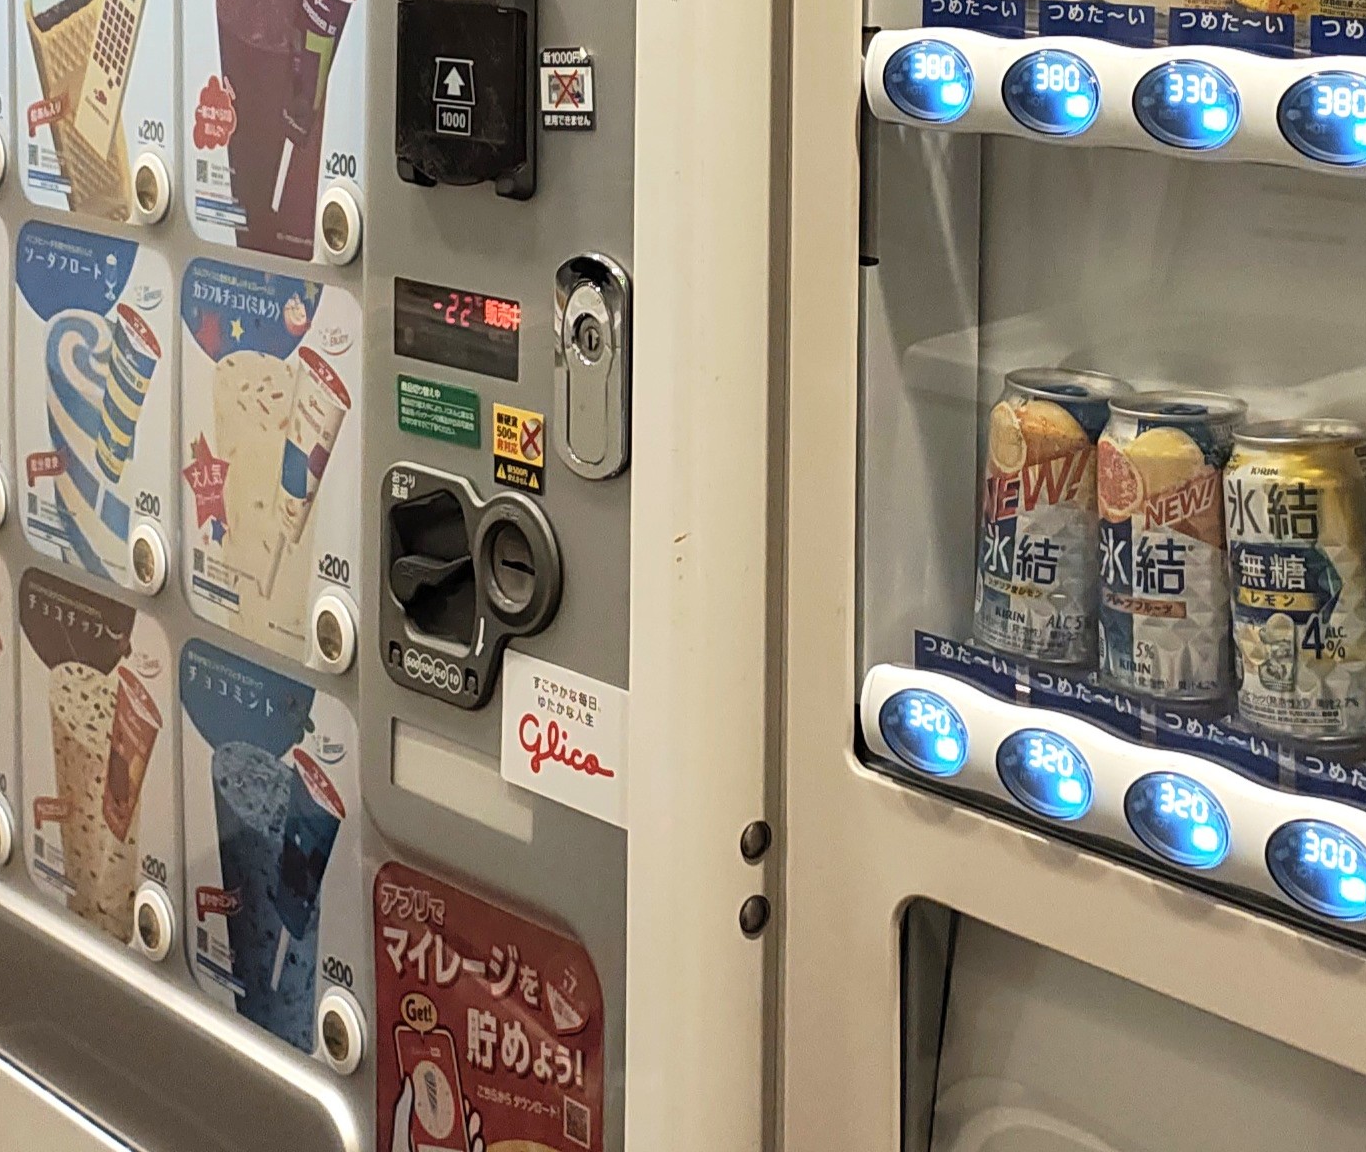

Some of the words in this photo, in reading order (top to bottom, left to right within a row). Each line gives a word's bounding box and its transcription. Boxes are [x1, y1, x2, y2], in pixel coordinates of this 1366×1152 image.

[913, 53, 955, 79] 380
[1035, 62, 1080, 91] 380
[1168, 73, 1218, 103] 330
[138, 119, 165, 144] ¥200
[441, 112, 466, 129] 1000
[544, 115, 591, 126] 使用できません
[325, 151, 357, 179] ¥200
[26, 248, 102, 279] ソーダフロート
[193, 280, 282, 321] カラフルチョコ(ミルク)
[484, 298, 522, 332] 販売中
[496, 412, 518, 428] 新硬貨
[496, 426, 518, 442] 500円
[191, 464, 223, 489] 大人気
[391, 471, 416, 488] おつり
[1251, 466, 1279, 477] KIRIN
[137, 491, 161, 517] ¥200
[1144, 480, 1216, 530] NEW!
[1228, 479, 1325, 540] 氷結
[318, 553, 350, 584] ¥200
[985, 525, 1066, 585] 氷結
[1100, 527, 1194, 595] 氷結
[1238, 549, 1308, 591] 無糖
[1248, 591, 1296, 608] レモン
[995, 607, 1026, 624] KIRIN
[1136, 640, 1155, 657] 5%
[436, 666, 447, 680] 50
[449, 673, 460, 686] 10
[1119, 659, 1151, 674] KIRIN
[189, 665, 274, 717] チョコミント
[537, 696, 595, 728] ゆたかな人生
[909, 698, 951, 734] 320
[519, 713, 615, 782] Glico
[1028, 739, 1074, 777] 320
[1159, 782, 1209, 825] 320
[1302, 830, 1358, 874] 300
[322, 955, 354, 988] ¥200
[383, 925, 541, 1006] マイレージを
[406, 1001, 433, 1024] Get!
[466, 1007, 584, 1086] 貯めよう!
